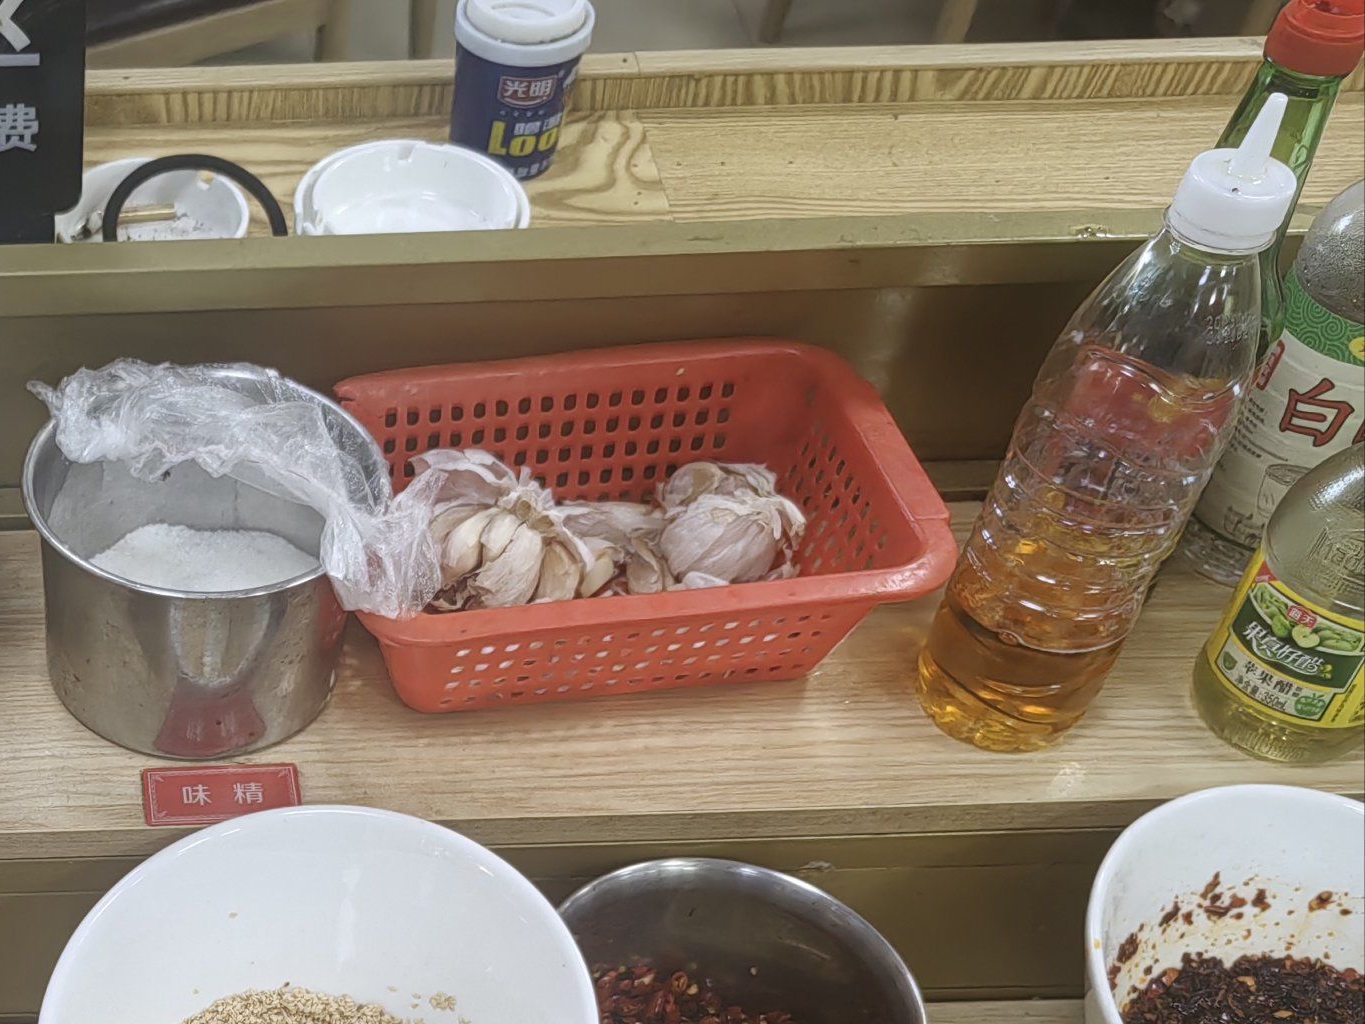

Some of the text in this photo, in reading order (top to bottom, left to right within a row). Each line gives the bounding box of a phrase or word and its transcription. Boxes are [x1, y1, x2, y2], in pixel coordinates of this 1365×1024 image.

[503, 79, 553, 98] 光明
[1279, 377, 1365, 447] 白
[1289, 607, 1317, 627] 海天
[1243, 660, 1292, 697] 苹果醋
[182, 782, 264, 806] 味精
